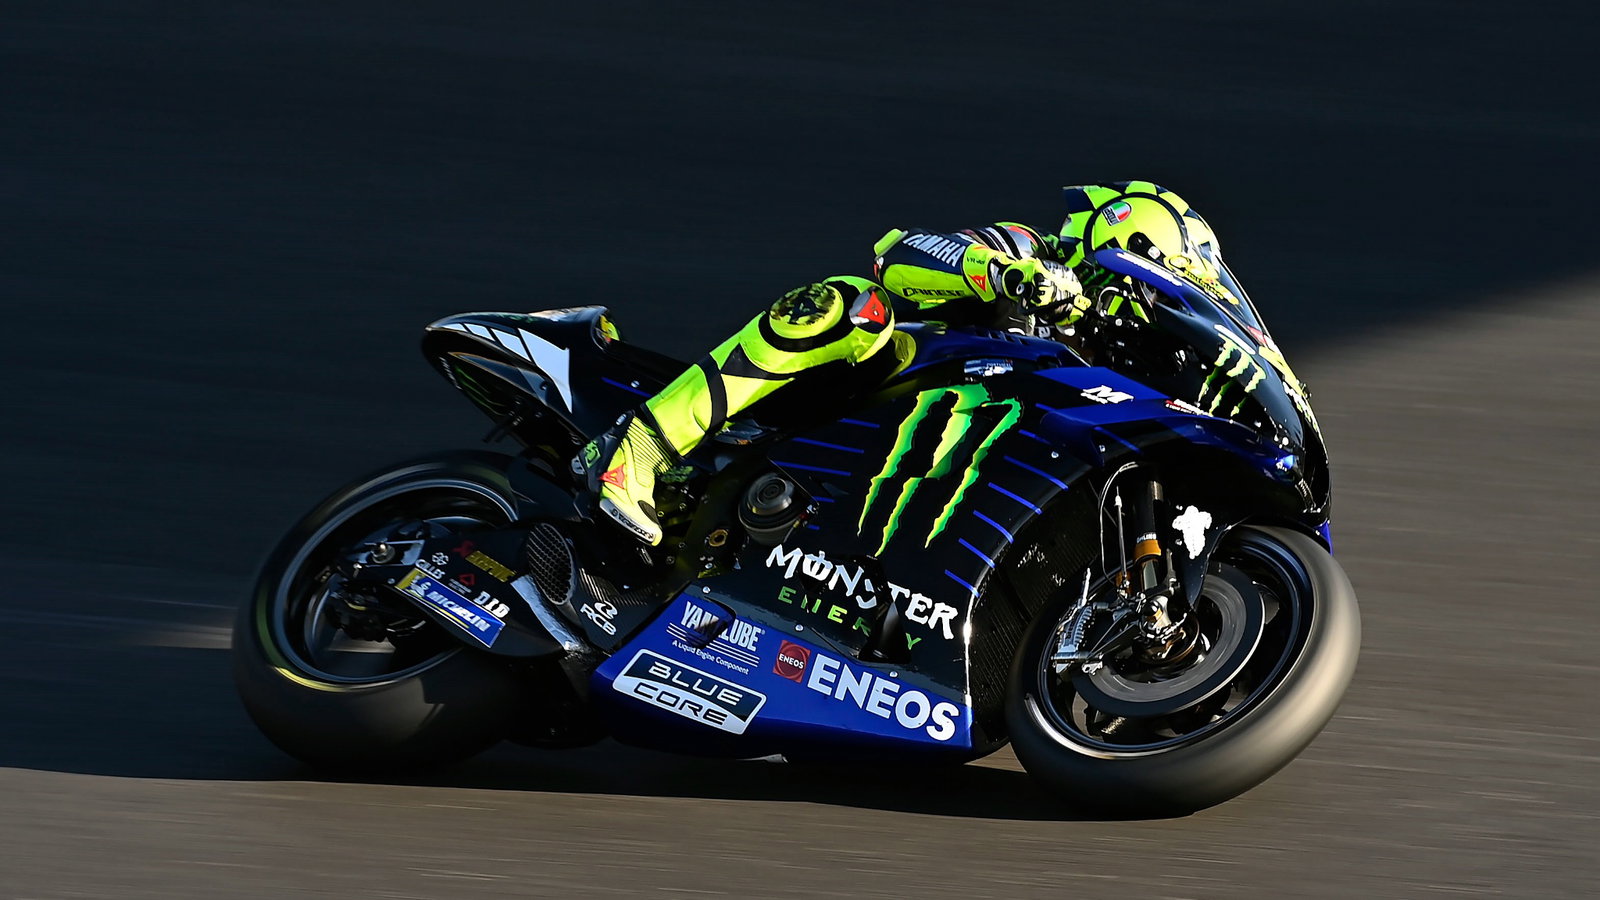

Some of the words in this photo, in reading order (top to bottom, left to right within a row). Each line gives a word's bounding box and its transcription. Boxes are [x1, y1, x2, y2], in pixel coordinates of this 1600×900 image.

[902, 233, 966, 268] YAMAHA
[902, 286, 965, 297] DAINESE
[415, 558, 446, 580] GILLES
[765, 543, 959, 640] MONSTER
[426, 590, 491, 632] MICHELIN
[580, 603, 617, 636] RCB
[777, 585, 923, 651] ENERY
[678, 642, 697, 654] Liquid
[695, 647, 715, 662] Engine
[715, 656, 749, 675] Component
[778, 652, 805, 669] ENEOS
[647, 660, 743, 706] BLUE
[806, 652, 960, 742] ENEOS
[633, 682, 729, 726] CORE
